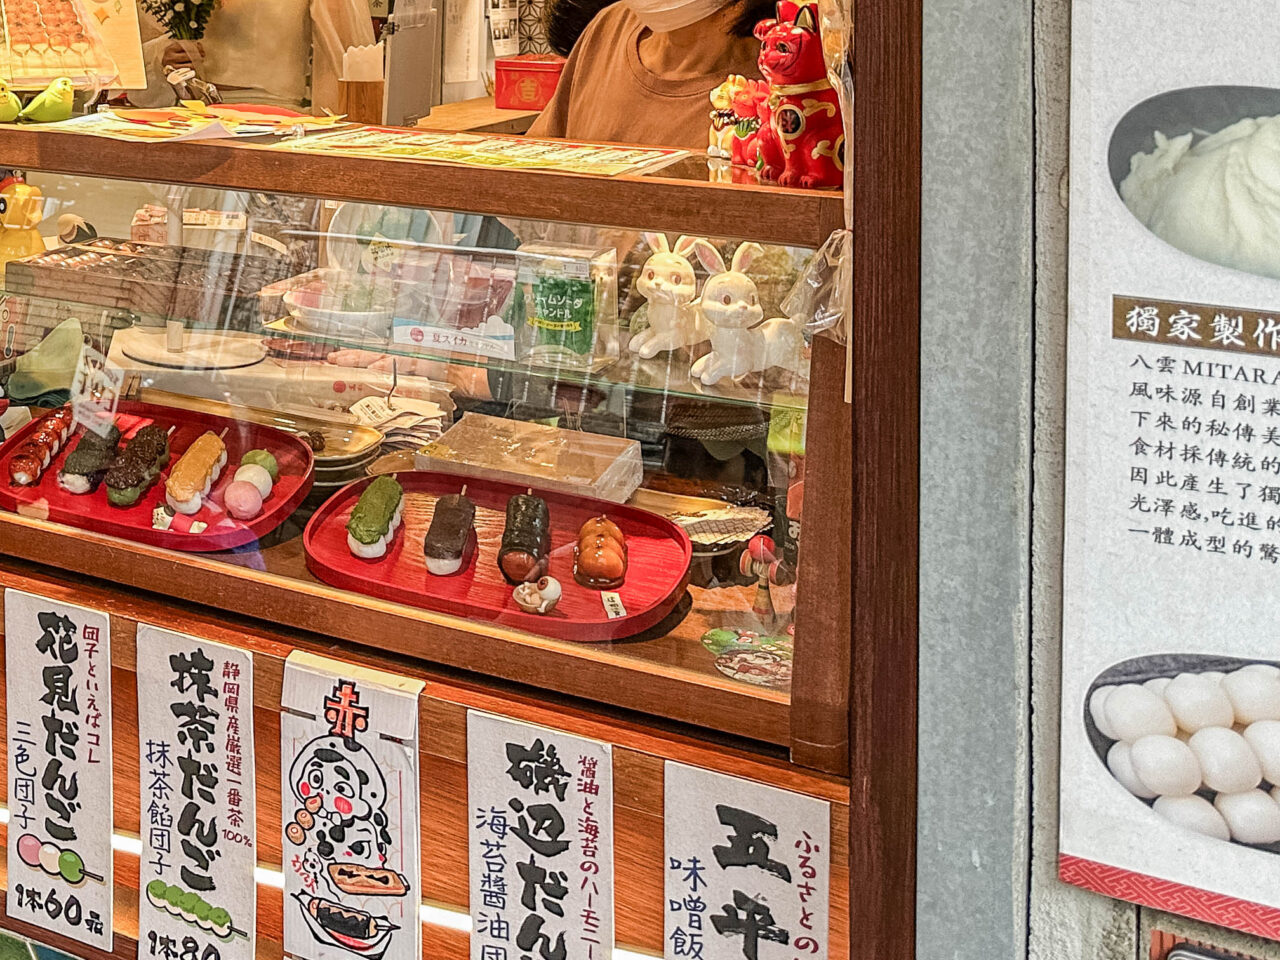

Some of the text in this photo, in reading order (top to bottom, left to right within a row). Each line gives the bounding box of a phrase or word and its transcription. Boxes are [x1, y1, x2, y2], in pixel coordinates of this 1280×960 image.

[1126, 305, 1280, 350] 獨家製作
[1130, 354, 1176, 374] 八雲
[1129, 382, 1280, 417] 風味源自創業
[1130, 411, 1280, 447] 下來的秘傳美
[1129, 436, 1280, 475] 食材採傳統的
[1130, 466, 1280, 505] 因此產生了獨
[1128, 526, 1280, 564] 一體成型的驚
[35, 611, 82, 841] 花見だんご
[82, 624, 102, 764] 団子といえばコレ
[323, 678, 370, 737] 赤
[13, 720, 37, 829] 三色団子
[169, 647, 221, 891] 抹茶だんご
[222, 660, 244, 828] 静岡県産厳選一番茶
[146, 739, 174, 876] 抹茶餡団子
[221, 828, 253, 848] 100%
[669, 856, 708, 960] 味噌飯
[709, 804, 792, 960] 五平
[793, 830, 821, 954] ふるさとの
